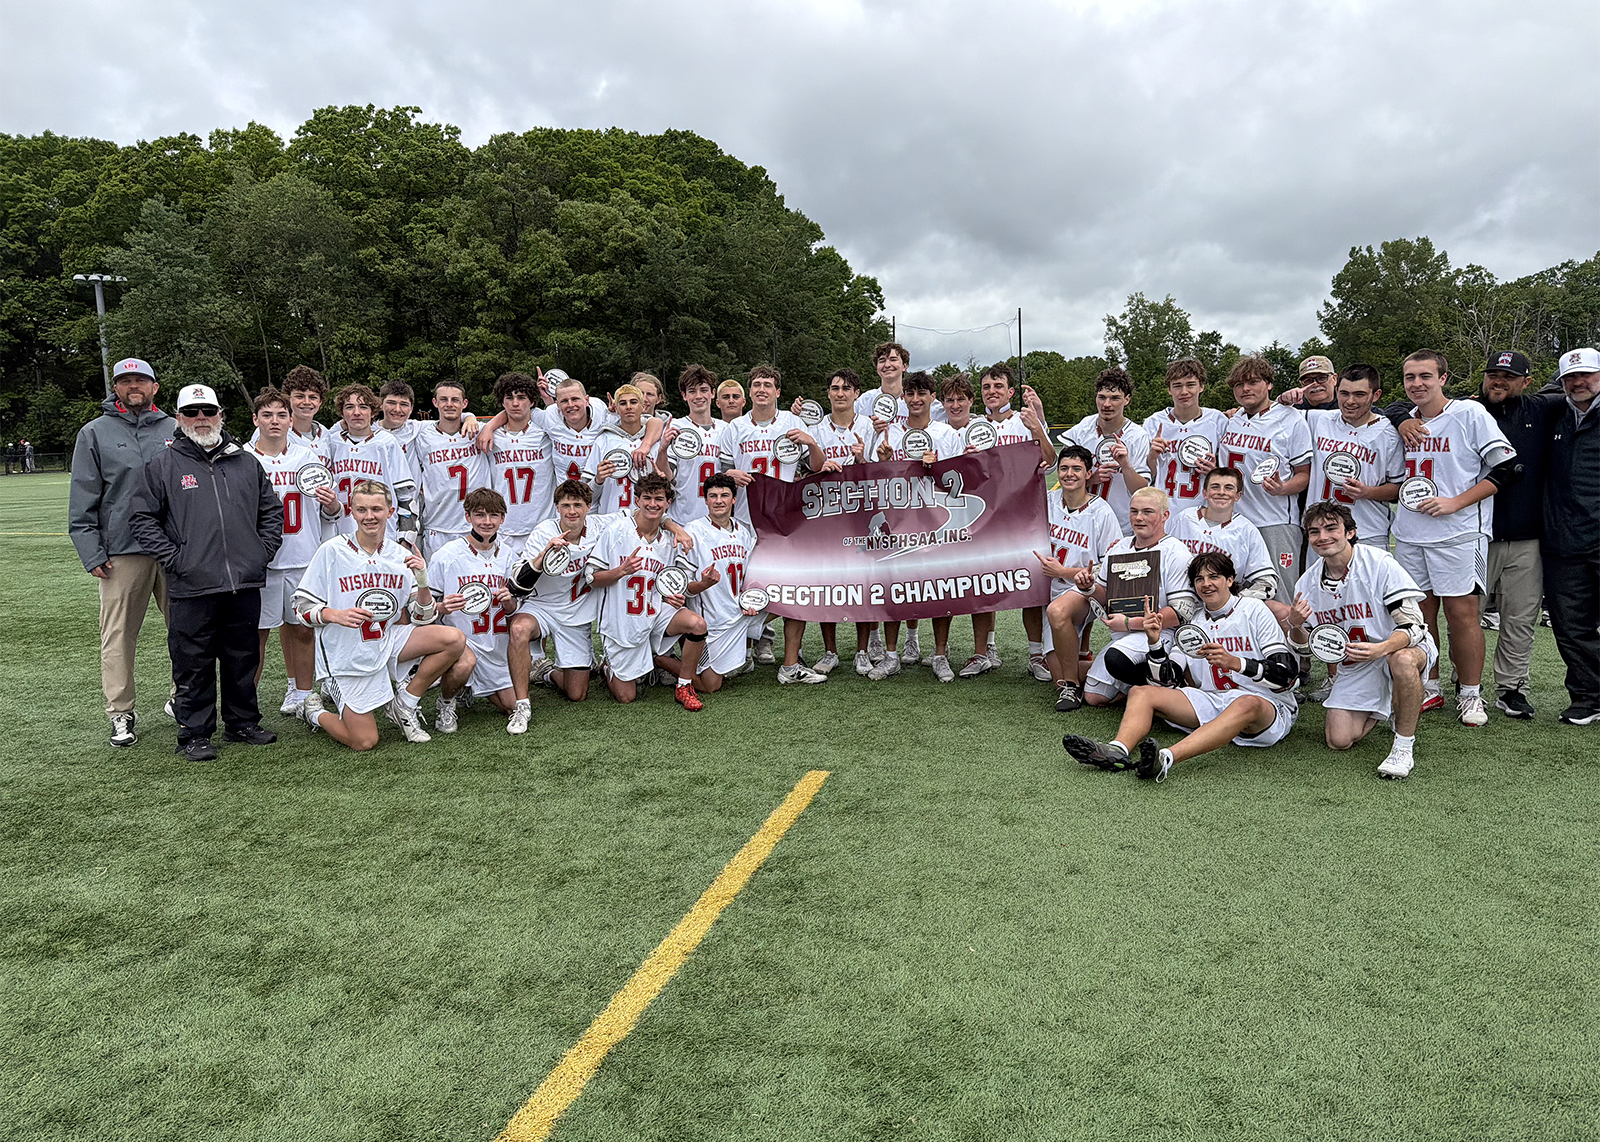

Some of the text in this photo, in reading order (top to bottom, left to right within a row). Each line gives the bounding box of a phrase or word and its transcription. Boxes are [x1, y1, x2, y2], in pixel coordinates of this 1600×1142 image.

[493, 448, 544, 465] NISKAYUNA
[739, 439, 776, 455] NISKAY
[447, 465, 469, 502] 7
[504, 466, 536, 505] 17
[802, 470, 967, 519] SECTION 2
[1165, 459, 1201, 499] 43
[843, 537, 853, 546] OF
[854, 536, 866, 546] THE
[943, 528, 972, 544] INC.
[339, 573, 404, 593] NISKAYUNA
[766, 584, 863, 606] SECTION
[870, 584, 886, 605] 2
[891, 568, 1032, 605] CHAMPIONS
